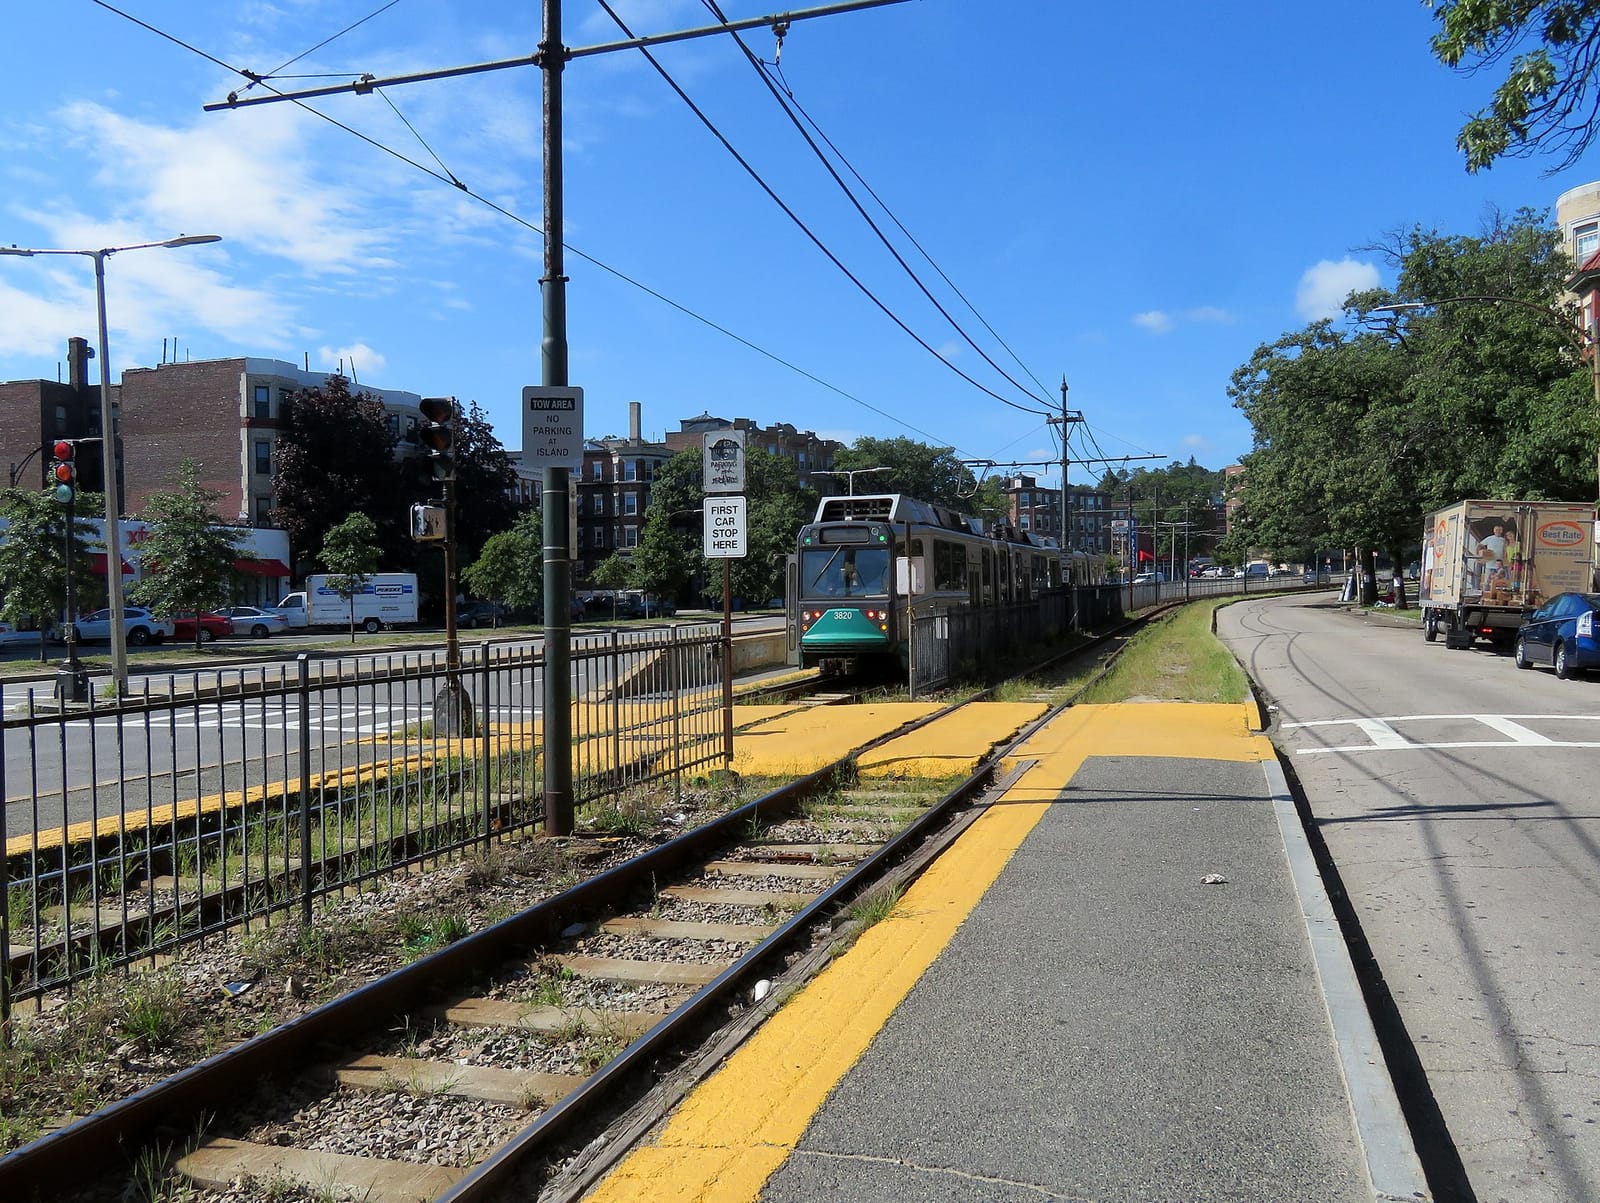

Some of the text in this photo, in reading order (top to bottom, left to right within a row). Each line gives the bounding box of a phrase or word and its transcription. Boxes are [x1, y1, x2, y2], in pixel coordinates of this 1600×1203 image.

[532, 399, 573, 409] TOW AREA
[546, 415, 560, 423] NO
[533, 427, 572, 435] PARKING
[536, 448, 569, 456] ISLAND
[711, 505, 739, 515] FIRST
[715, 517, 735, 526] CAR
[712, 529, 738, 538] STOP
[1562, 531, 1582, 539] Rate
[712, 540, 738, 550] HERE
[833, 611, 853, 620] 3820
